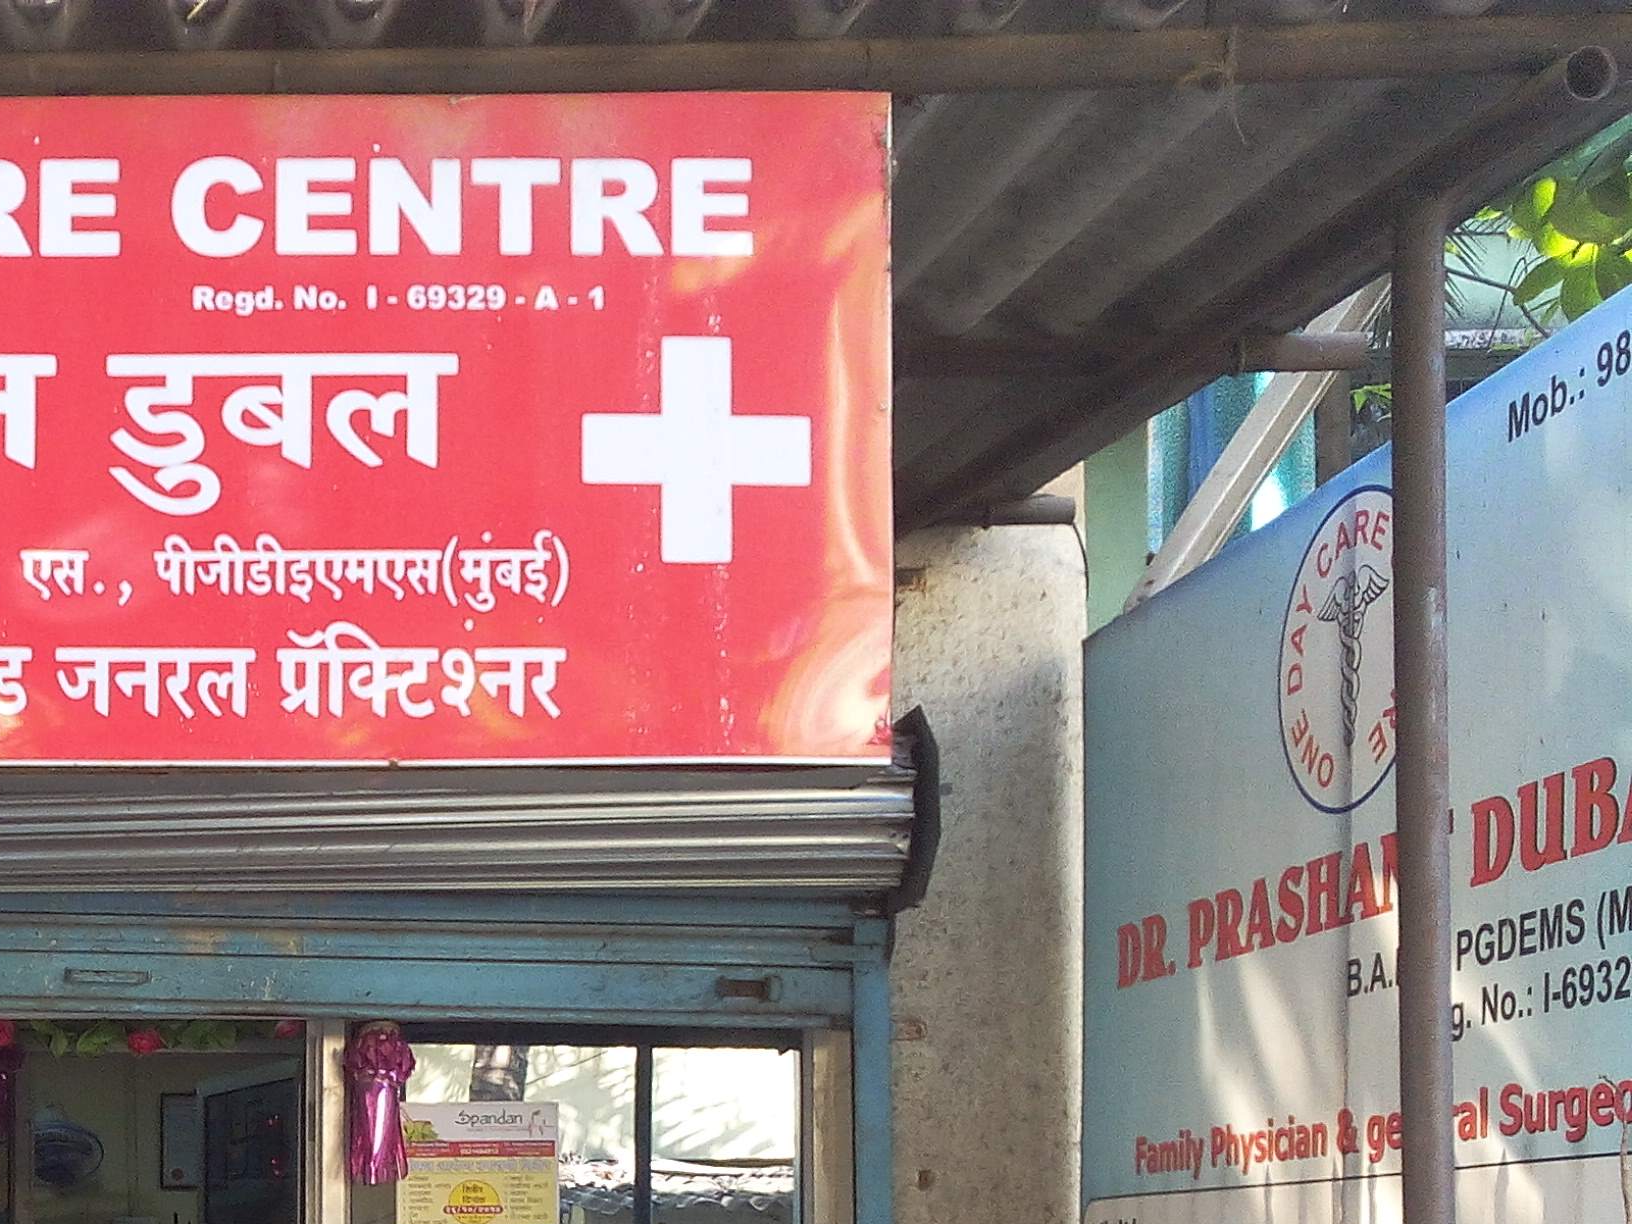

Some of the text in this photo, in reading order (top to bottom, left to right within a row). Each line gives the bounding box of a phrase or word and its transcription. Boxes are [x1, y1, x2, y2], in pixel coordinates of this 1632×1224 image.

[170, 155, 755, 258] CENTRE
[191, 284, 284, 317] Regd.
[293, 284, 347, 312] No.
[105, 352, 460, 517] डुबल
[55, 646, 256, 719] जनरल
[1287, 509, 1390, 788] ONE DAY CARE
[1116, 757, 1632, 990] DR. PRASHA DUB
[1347, 952, 1399, 998] B.A.
[1456, 898, 1587, 973] PGDEMS
[455, 1109, 523, 1127] Spandan
[1135, 1129, 1204, 1181] Family
[1210, 1114, 1329, 1176] Physician
[1336, 1107, 1360, 1155] &
[1368, 1086, 1489, 1163] geal
